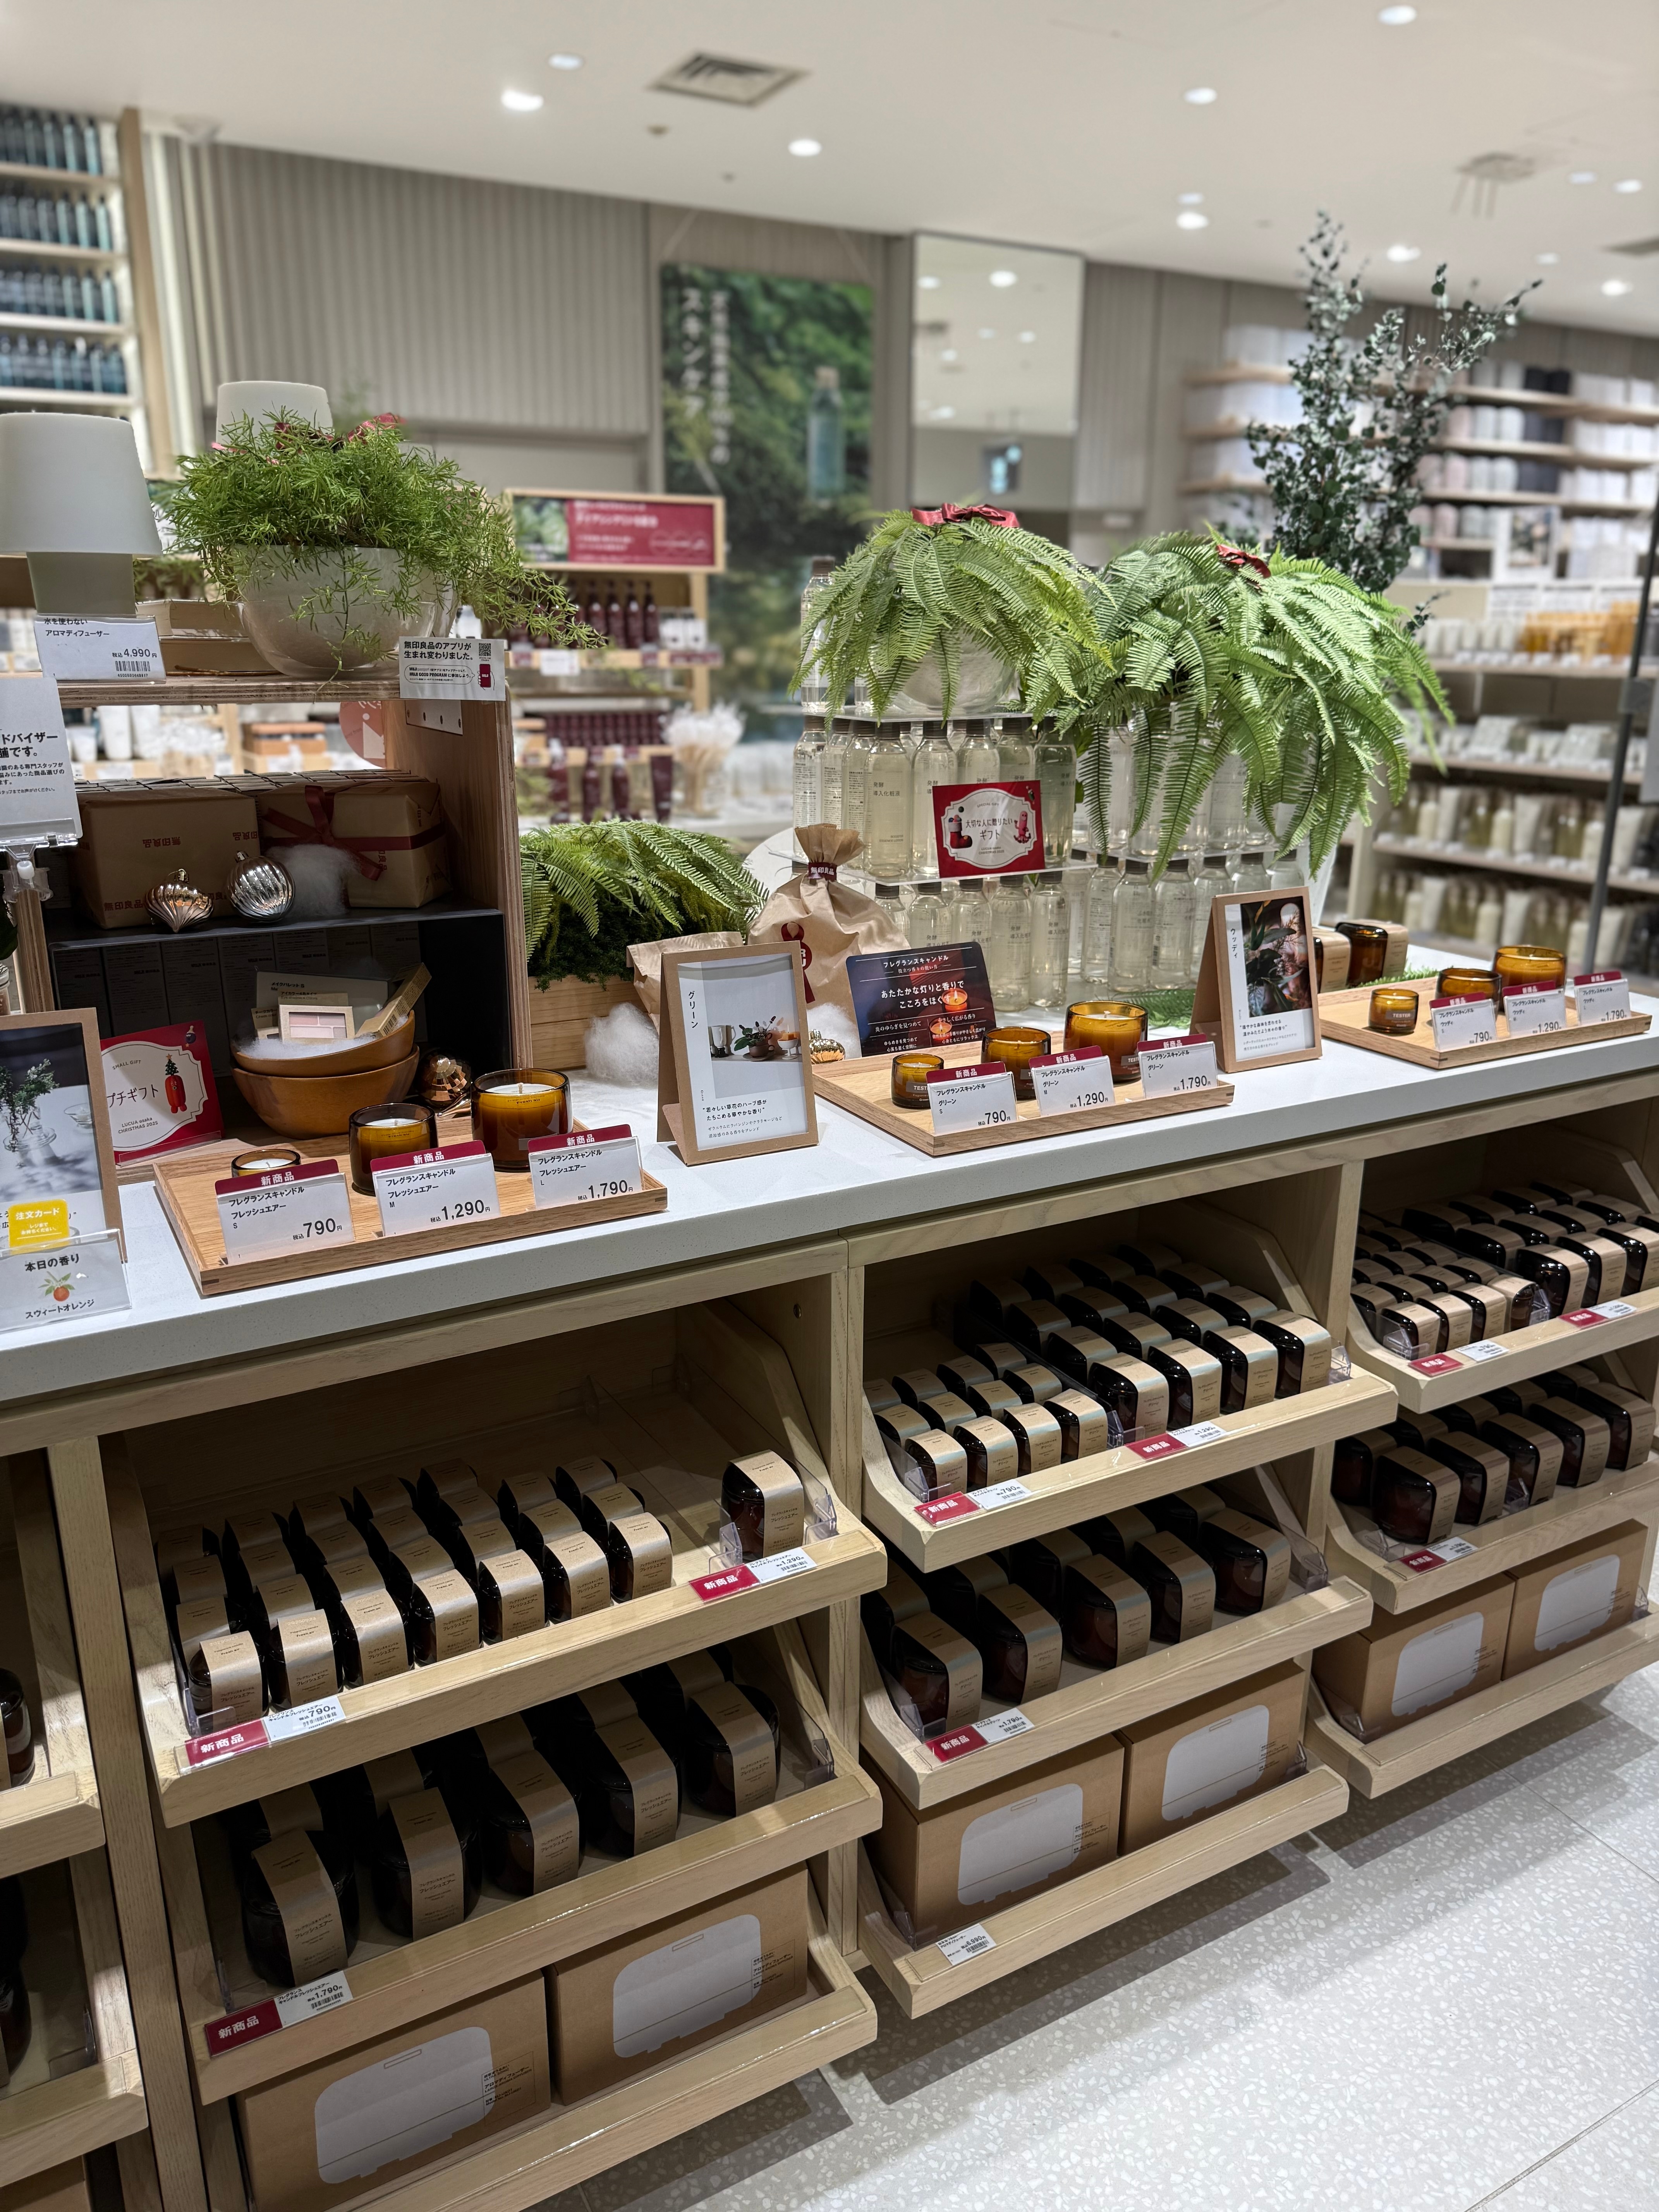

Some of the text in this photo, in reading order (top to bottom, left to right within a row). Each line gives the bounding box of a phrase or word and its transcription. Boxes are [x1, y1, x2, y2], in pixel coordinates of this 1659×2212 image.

[404, 641, 471, 650] 無印良品のアプリが
[404, 651, 473, 660] 生まれ変わりました。
[2, 732, 58, 745] ドバイザー
[965, 818, 1013, 828] 大切な人に贈りたい
[980, 830, 1000, 840] ギフト
[811, 866, 834, 875] 無印良品
[104, 899, 143, 911] 無印良品
[883, 955, 948, 968] フレグランスキャンドル
[881, 980, 964, 999] あたたかな灯りと香りで
[899, 995, 951, 1009] こころをほぐす
[688, 991, 698, 1029] グリーン
[875, 1021, 921, 1033] 炎のゆらぎを見つめて
[1163, 1040, 1182, 1049] 新商品
[1056, 1054, 1077, 1064] 新商品
[1147, 1050, 1190, 1061] フレグランスキャンドル
[112, 1061, 129, 1070] SMALL
[1041, 1065, 1085, 1078] フレグランスキャンドル
[955, 1068, 977, 1079] 新商品
[106, 1084, 158, 1108] プチギフト
[936, 1084, 986, 1096] フレグランスキャンドル
[118, 1124, 145, 1134] CHRISTMAS
[567, 1134, 595, 1146] 新商品
[413, 1151, 445, 1164] 新商品
[538, 1149, 602, 1164] フレグランスキャンドル
[539, 1164, 586, 1176] フレッシュエアー
[261, 1171, 295, 1186] 新商品
[386, 1168, 456, 1186] フレグランスキャンドル
[388, 1185, 439, 1199] フレッシュエアー
[578, 1180, 633, 1200] 税込1,790円
[229, 1187, 304, 1207] フレグランスキャンドル
[16, 1208, 60, 1220] 注文カード
[231, 1204, 286, 1219] フレッシュエアー
[430, 1200, 490, 1223] 税込1,290円
[293, 1218, 342, 1240] 税込790円
[25, 1254, 79, 1271] 本日の香り
[26, 1299, 94, 1319] スウィートオレンジ
[1143, 1441, 1170, 1453] 新商品
[927, 1499, 958, 1514] 新商品
[703, 1575, 738, 1590] 新商品
[368, 1647, 400, 1659] フレッシュエアー
[297, 1673, 329, 1686] フレッシュエアー
[221, 1692, 255, 1702] フレッシュエアー
[200, 1733, 244, 1753] 新商品
[941, 1735, 970, 1750] 新商品
[419, 1879, 455, 1894] フレッシュエアー
[295, 1919, 333, 1939] フレッシュエアー
[277, 1988, 303, 2001] フレグランス
[278, 1982, 330, 2004] キャンドルフレッシュエアー
[218, 2015, 259, 2040] 新商品
[485, 2066, 529, 2089] アロマディフューザー
